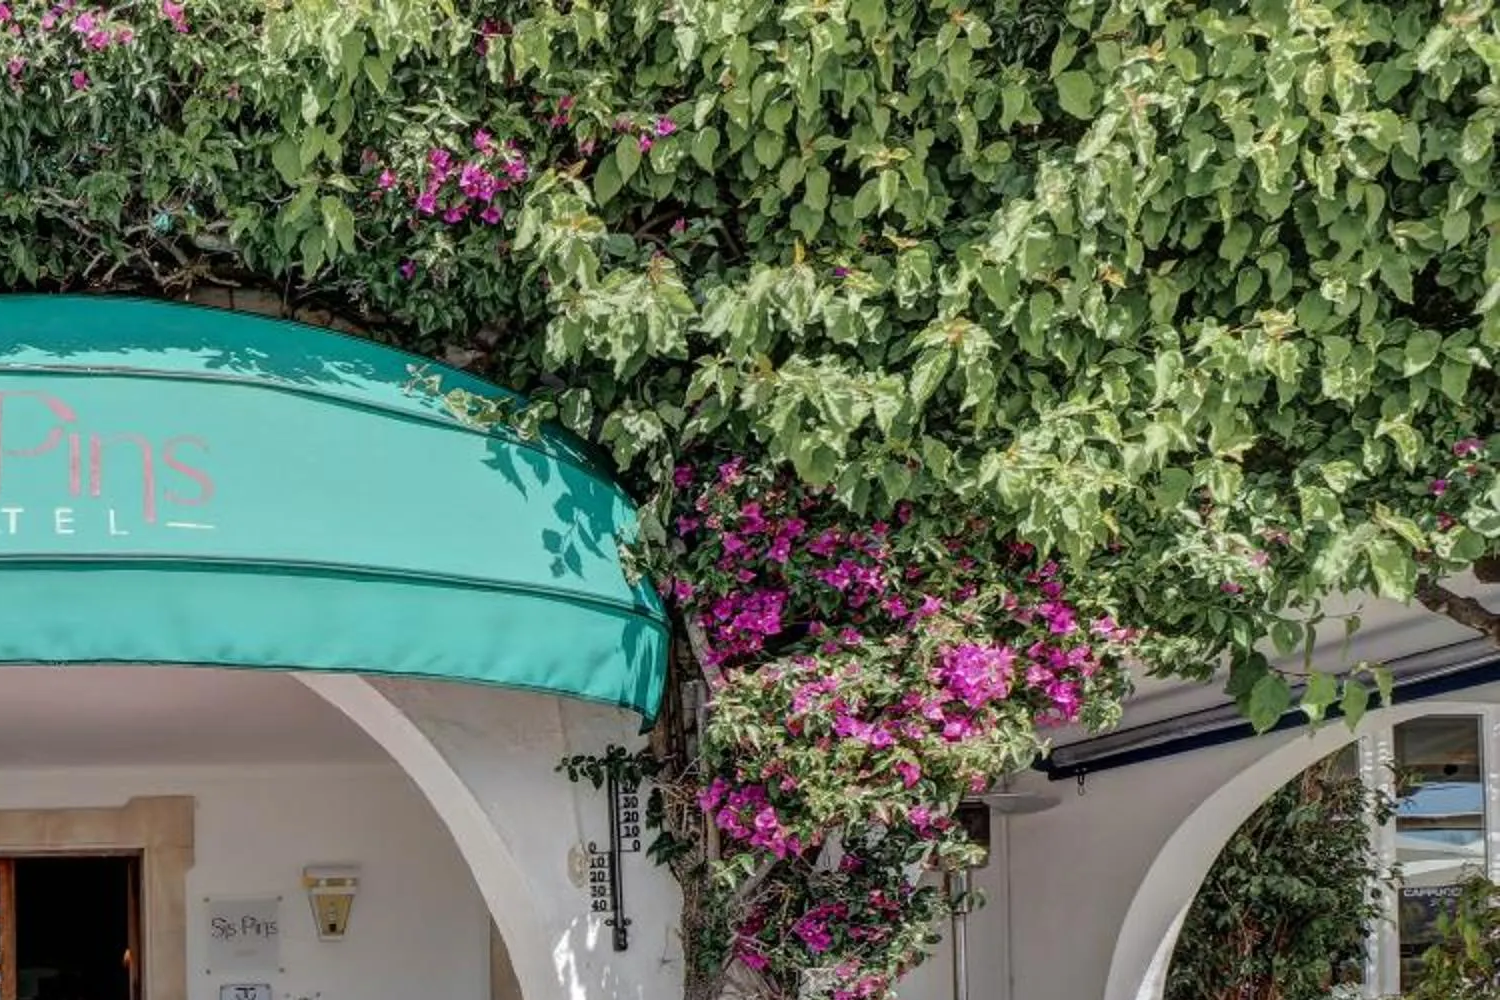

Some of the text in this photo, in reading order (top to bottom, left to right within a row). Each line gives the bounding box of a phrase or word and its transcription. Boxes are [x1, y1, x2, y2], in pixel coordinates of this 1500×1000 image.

[623, 811, 639, 823] 20
[623, 825, 640, 837] 10
[632, 839, 641, 852] 0
[590, 857, 605, 868] 10
[590, 871, 605, 882] 20
[591, 900, 607, 911] 40
